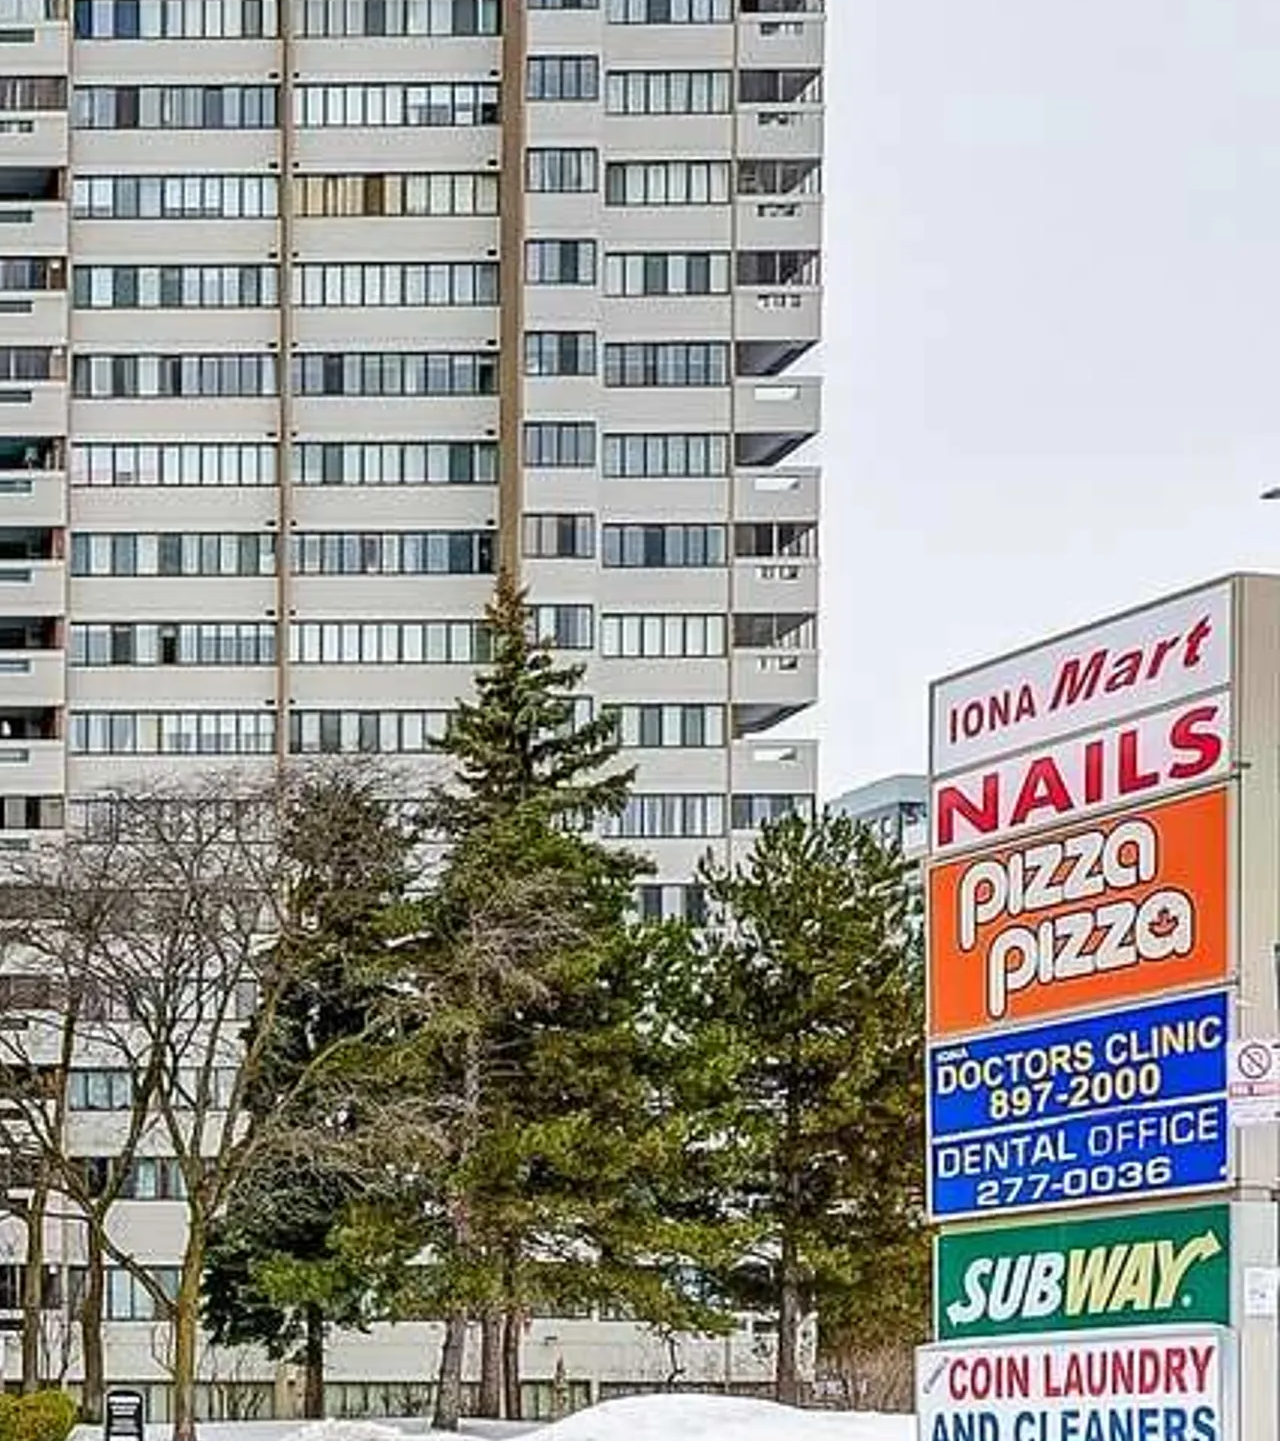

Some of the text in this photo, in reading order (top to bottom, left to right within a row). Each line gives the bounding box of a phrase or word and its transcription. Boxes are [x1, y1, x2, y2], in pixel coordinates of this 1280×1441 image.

[949, 614, 1213, 745] IONA Mart
[938, 705, 1223, 847] NAILS
[937, 1016, 1223, 1095] DOCTORS CLINIC
[990, 1062, 1161, 1120] 897-2000
[938, 1107, 1220, 1179] DENTAL OFFICE
[976, 1157, 1172, 1207] 277-0036
[947, 1230, 1221, 1326] SUBWAY
[948, 1355, 1030, 1401] COIN
[1043, 1345, 1216, 1399] LAUNDRY
